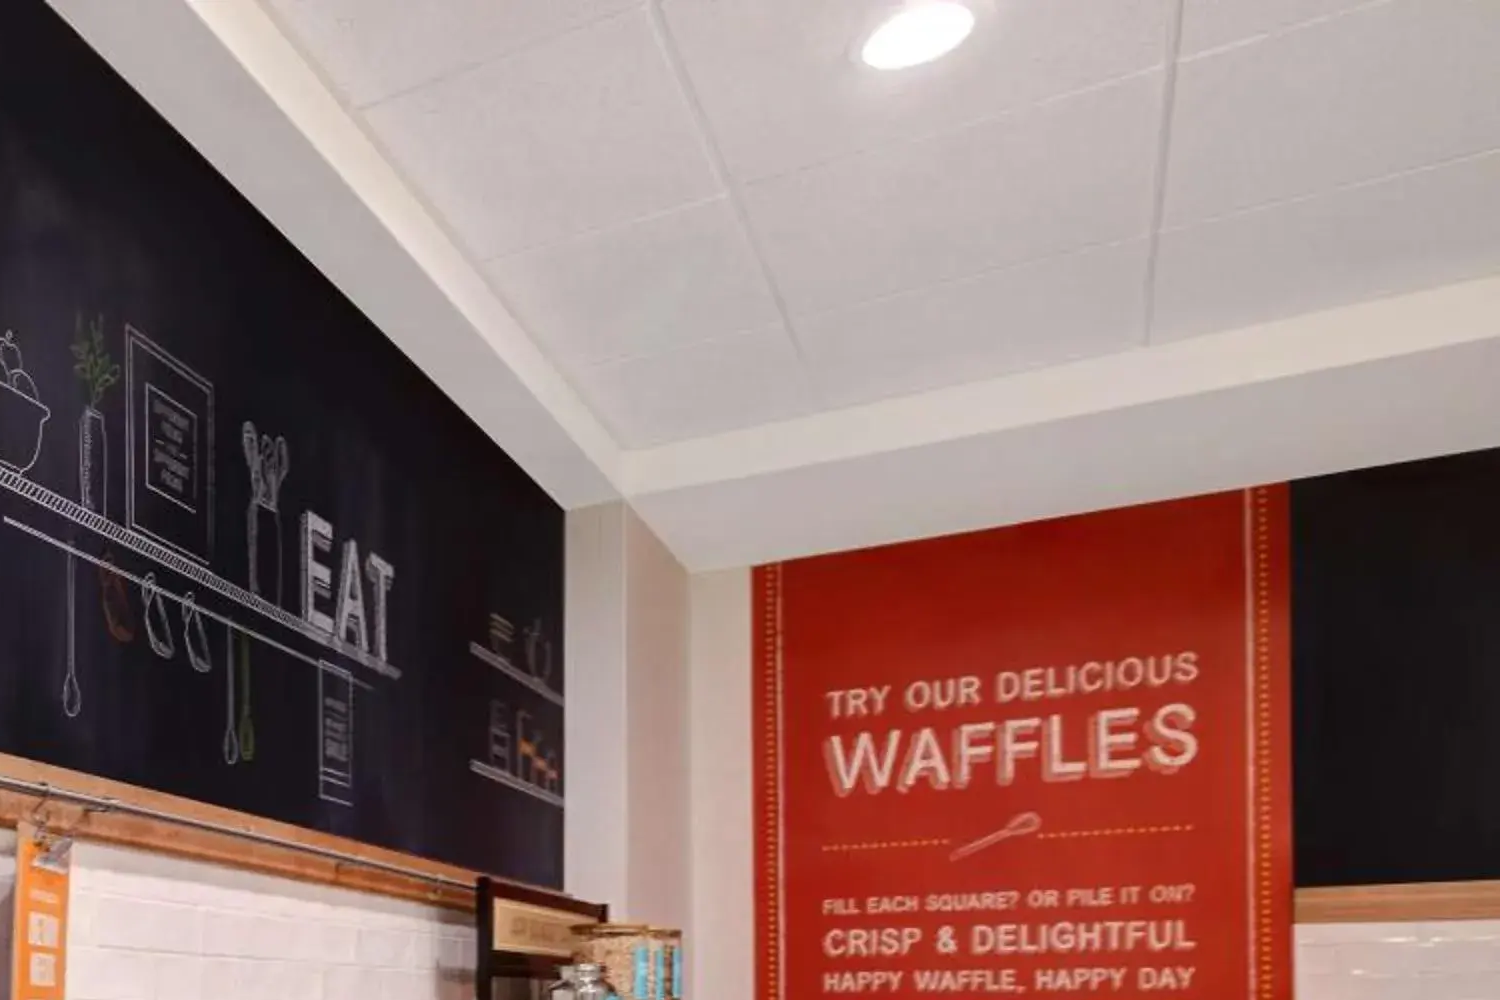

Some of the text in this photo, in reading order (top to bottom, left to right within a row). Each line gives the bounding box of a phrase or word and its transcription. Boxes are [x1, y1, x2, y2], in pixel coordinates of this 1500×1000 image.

[301, 510, 394, 662] EAT
[826, 651, 1199, 719] TRY OUR DELICIOUS
[824, 703, 1199, 797] WAFFLES
[822, 883, 1196, 916] FILL EACH SQUARE? OR PILE IT ON?
[823, 919, 1197, 957] CRISP & DELIGHTFUL
[822, 965, 1196, 994] HAPPY WAFFLE, HAPPY DAY
